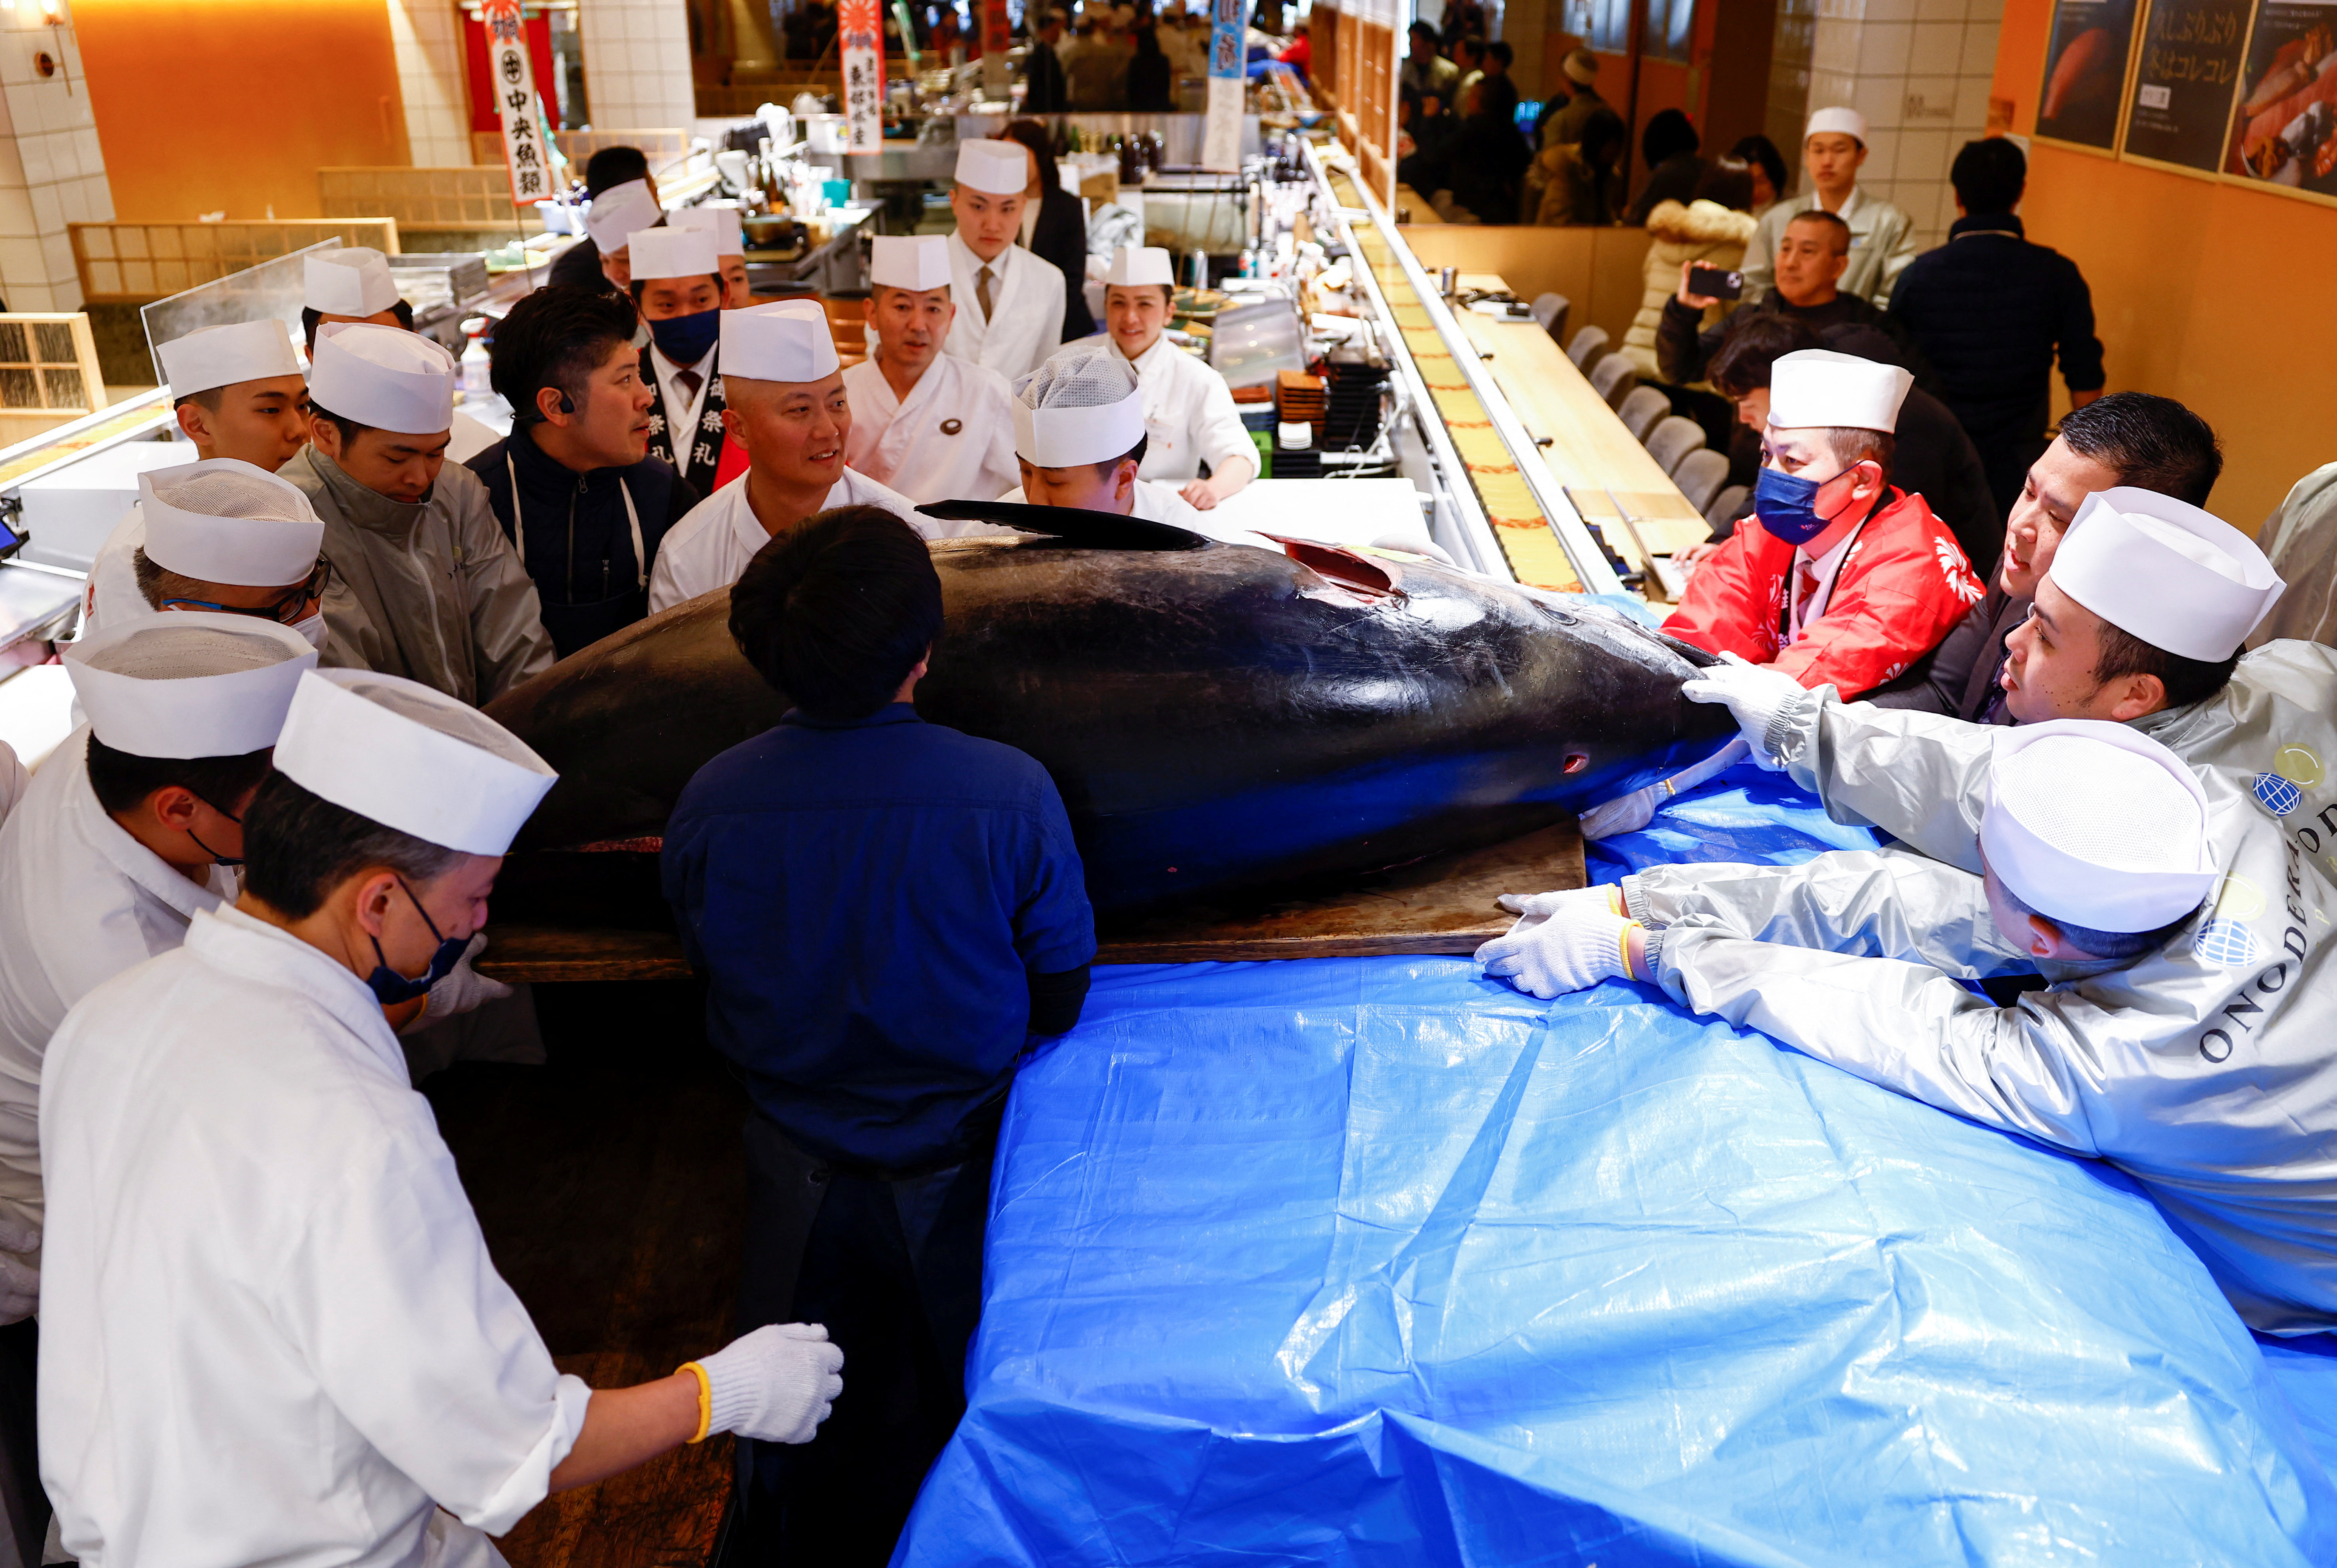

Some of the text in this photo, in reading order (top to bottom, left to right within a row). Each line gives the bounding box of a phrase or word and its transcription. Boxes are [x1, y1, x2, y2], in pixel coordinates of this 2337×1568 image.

[507, 89, 543, 194] 中央魚類
[2200, 840, 2307, 1063] ONODERA
